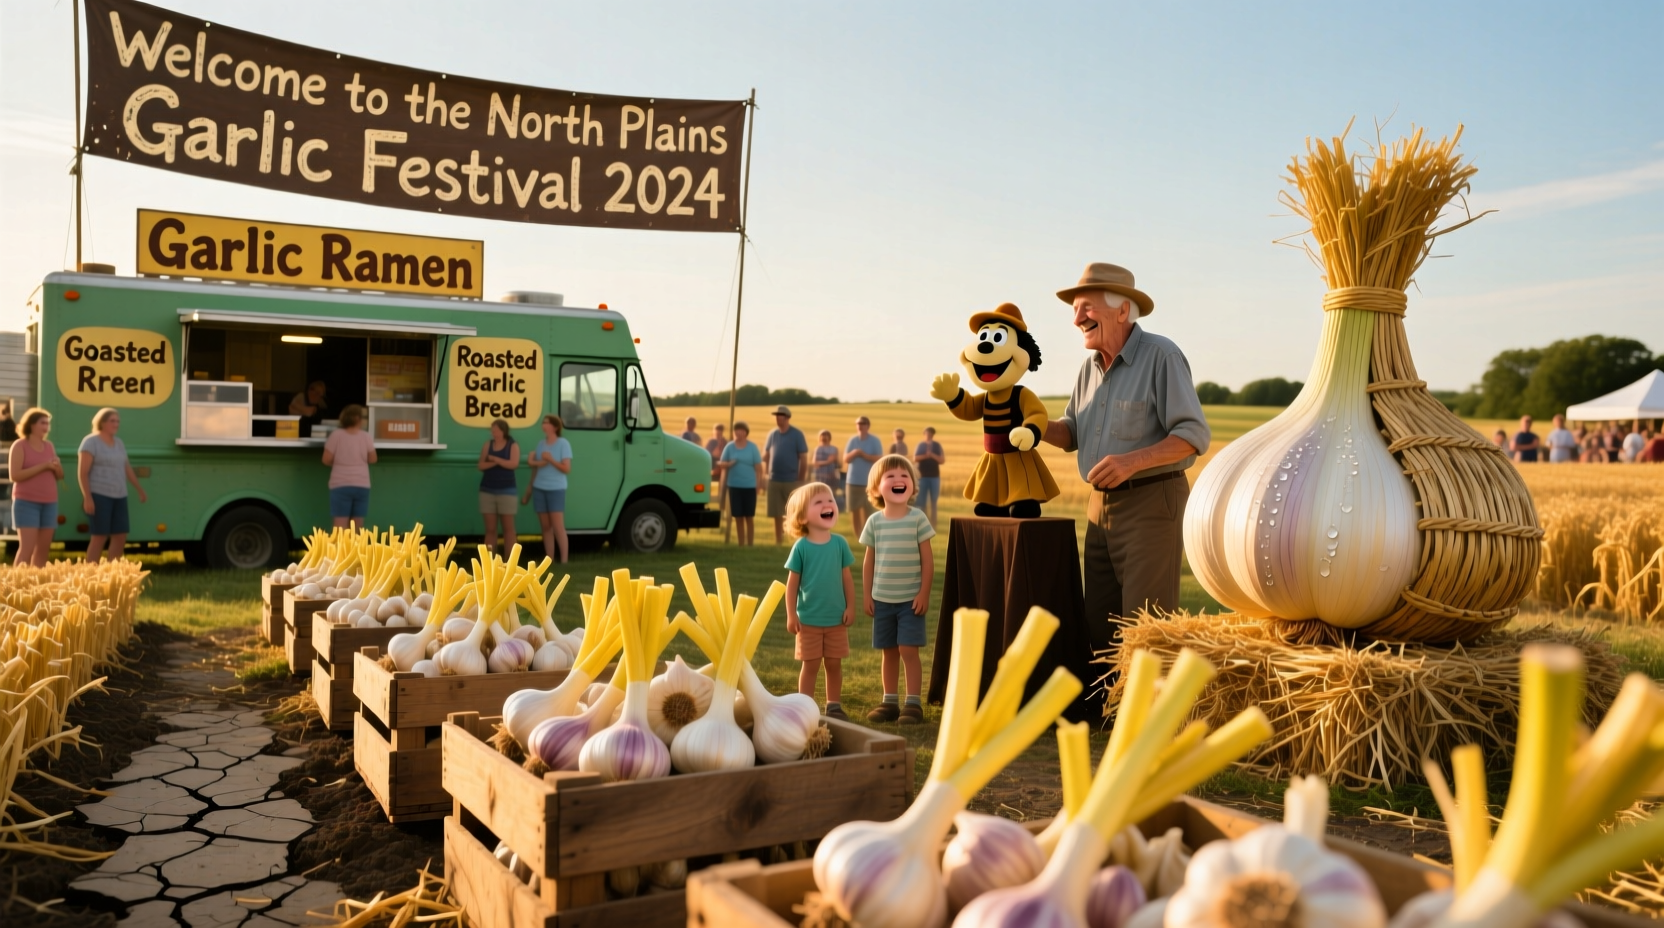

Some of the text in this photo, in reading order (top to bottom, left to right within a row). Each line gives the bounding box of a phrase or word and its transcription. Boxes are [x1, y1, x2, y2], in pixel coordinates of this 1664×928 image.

[110, 11, 728, 154] Welcome to the North Plains
[123, 84, 726, 219] Garlic Festival 2024
[148, 217, 473, 289] Garlic Ramen
[64, 335, 166, 364] Goasted
[457, 344, 537, 370] Roasted
[77, 365, 155, 395] Rreen
[464, 370, 526, 393] Garlic
[465, 395, 527, 418] Bread
